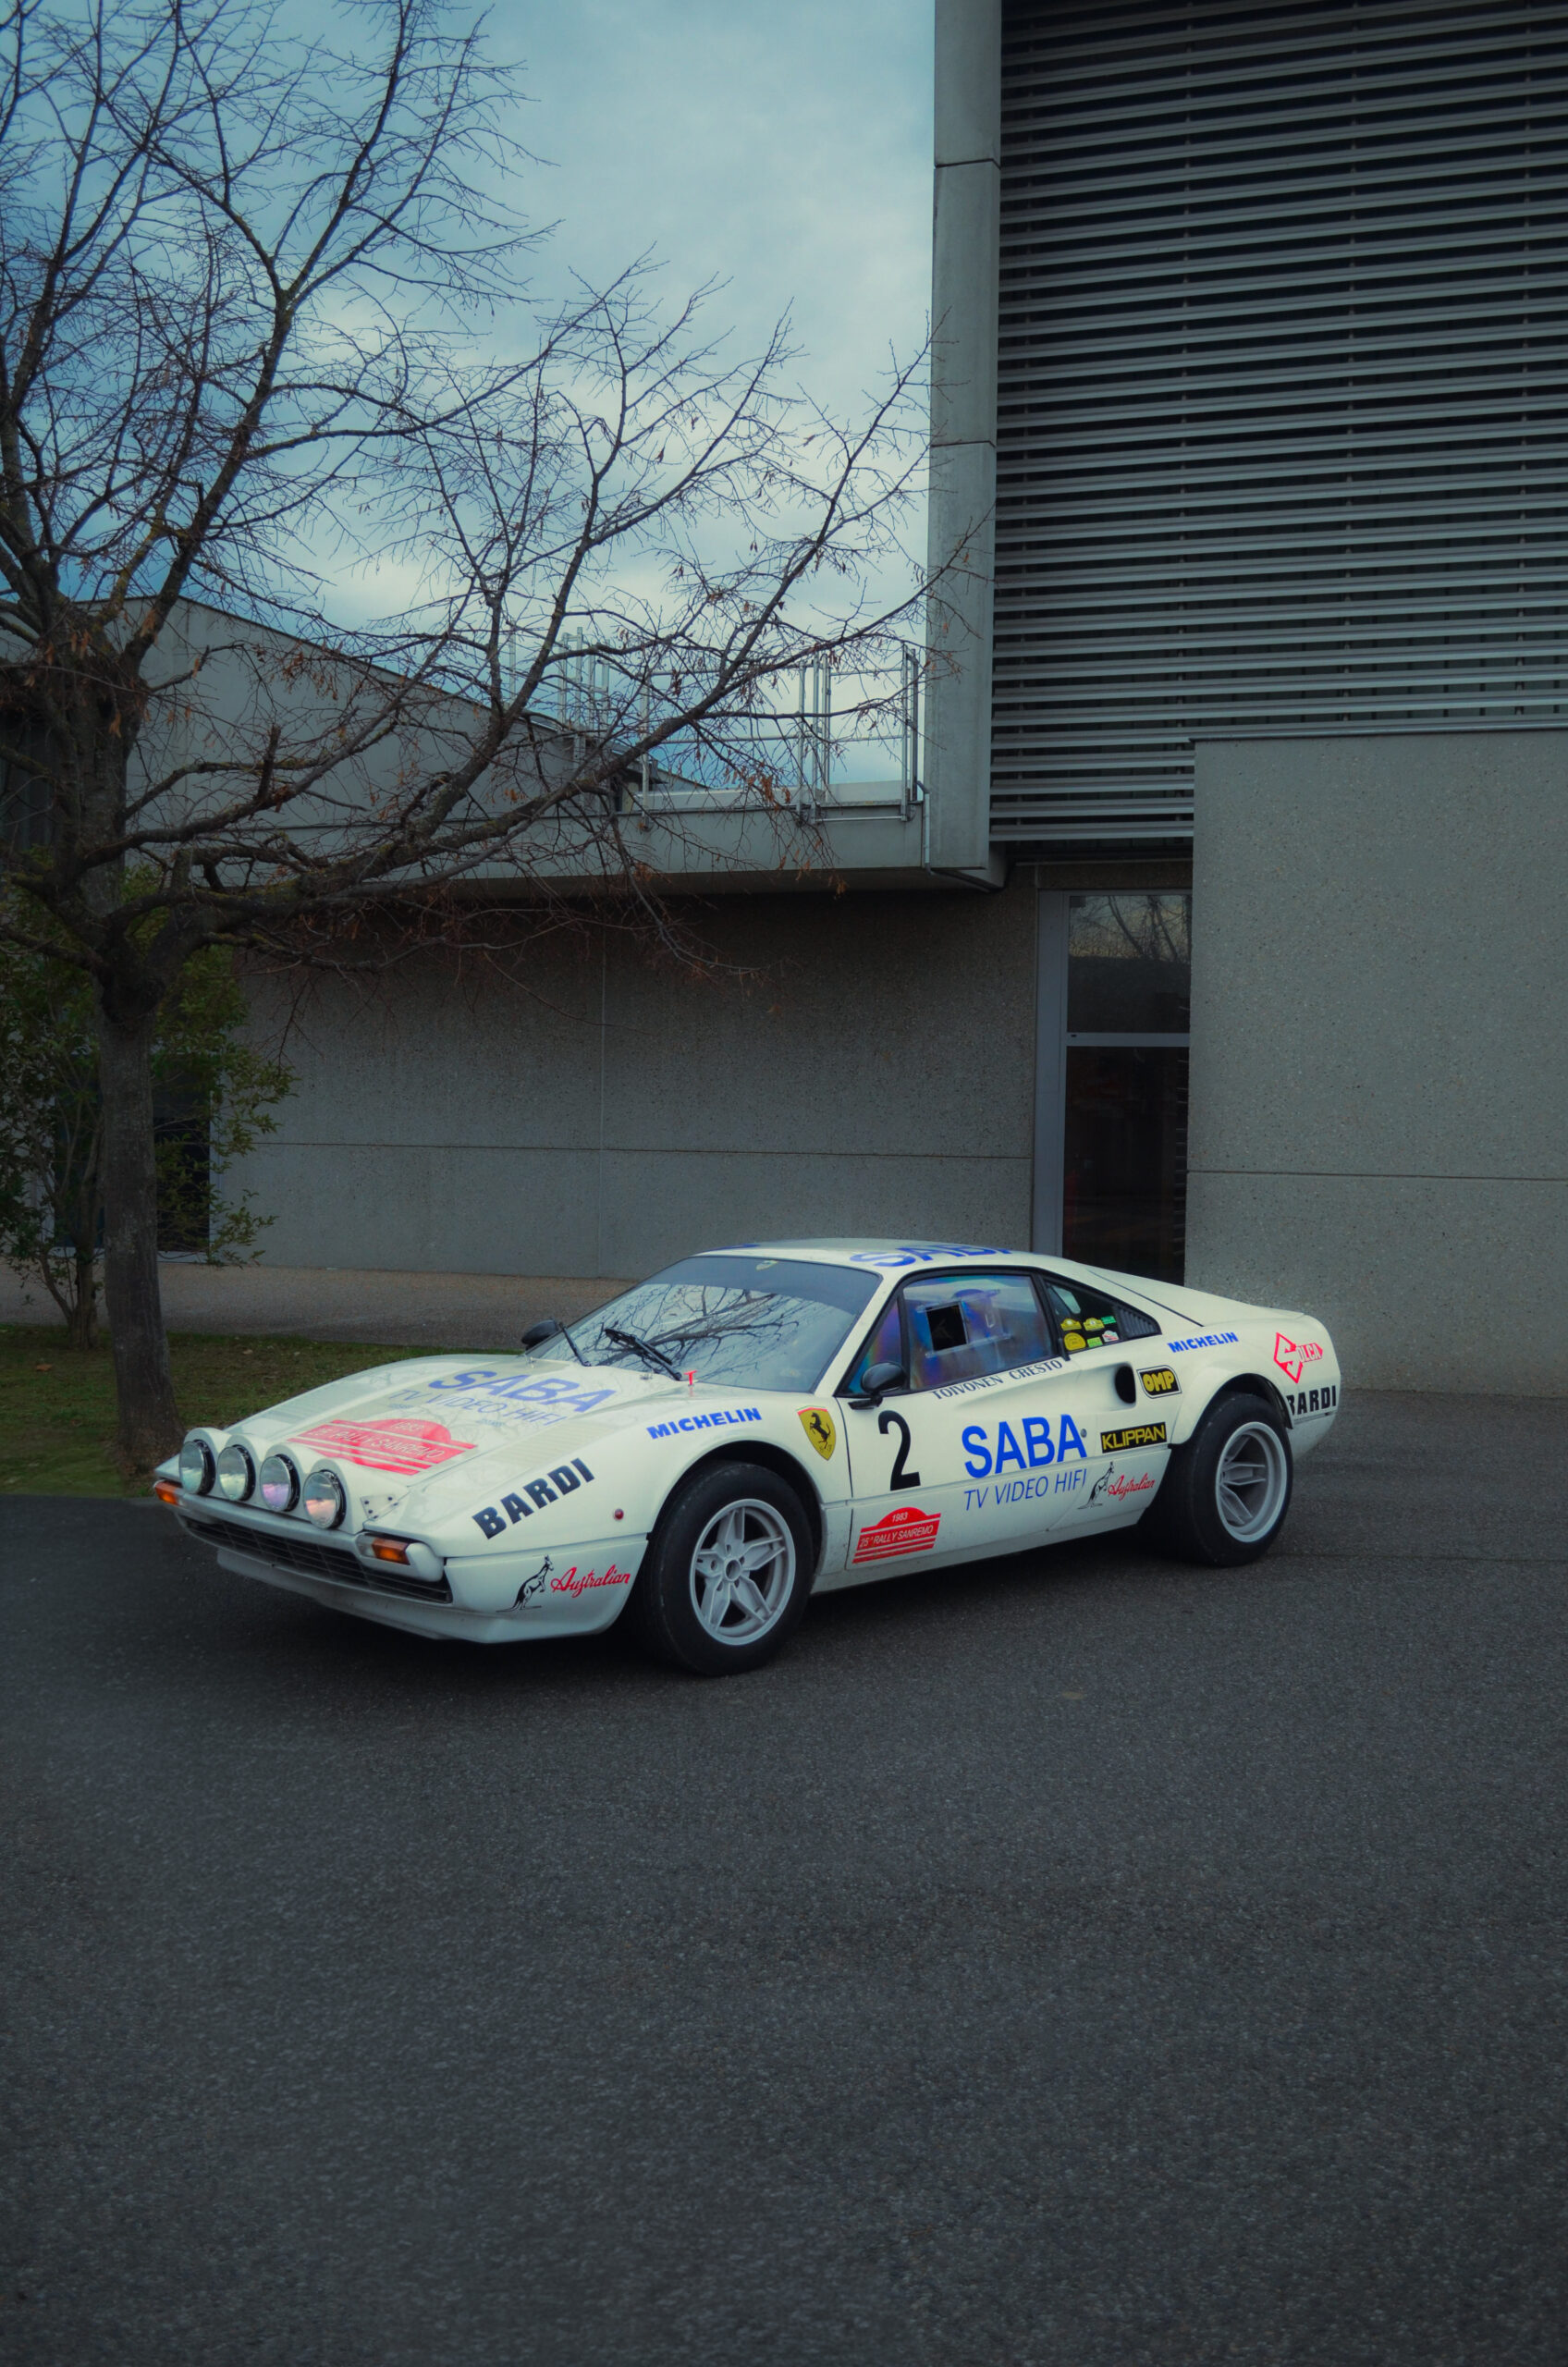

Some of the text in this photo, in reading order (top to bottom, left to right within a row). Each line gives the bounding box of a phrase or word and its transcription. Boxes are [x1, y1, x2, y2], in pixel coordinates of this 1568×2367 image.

[1167, 1332, 1239, 1353] MICHELIN
[428, 1370, 617, 1413] SABA
[932, 1359, 1062, 1400] TOIVONEN CRESTO
[1142, 1370, 1175, 1392] OMP
[388, 1389, 430, 1402] TV
[425, 1393, 508, 1414] VIDEO
[503, 1406, 568, 1427] HIFI
[646, 1407, 763, 1440] MICHELIN
[372, 1438, 446, 1459] SANREMO
[877, 1409, 921, 1491] 2
[961, 1414, 1088, 1479] SABA
[1101, 1424, 1166, 1451] KLIPPAN
[472, 1457, 595, 1539] BARDI
[963, 1468, 1087, 1511] TV VIDEO HIFI
[1107, 1472, 1156, 1501] Australian
[891, 1512, 909, 1523] 1983
[874, 1531, 899, 1545] RALLY
[898, 1525, 934, 1540] SANREMO
[550, 1564, 631, 1599] Australian
